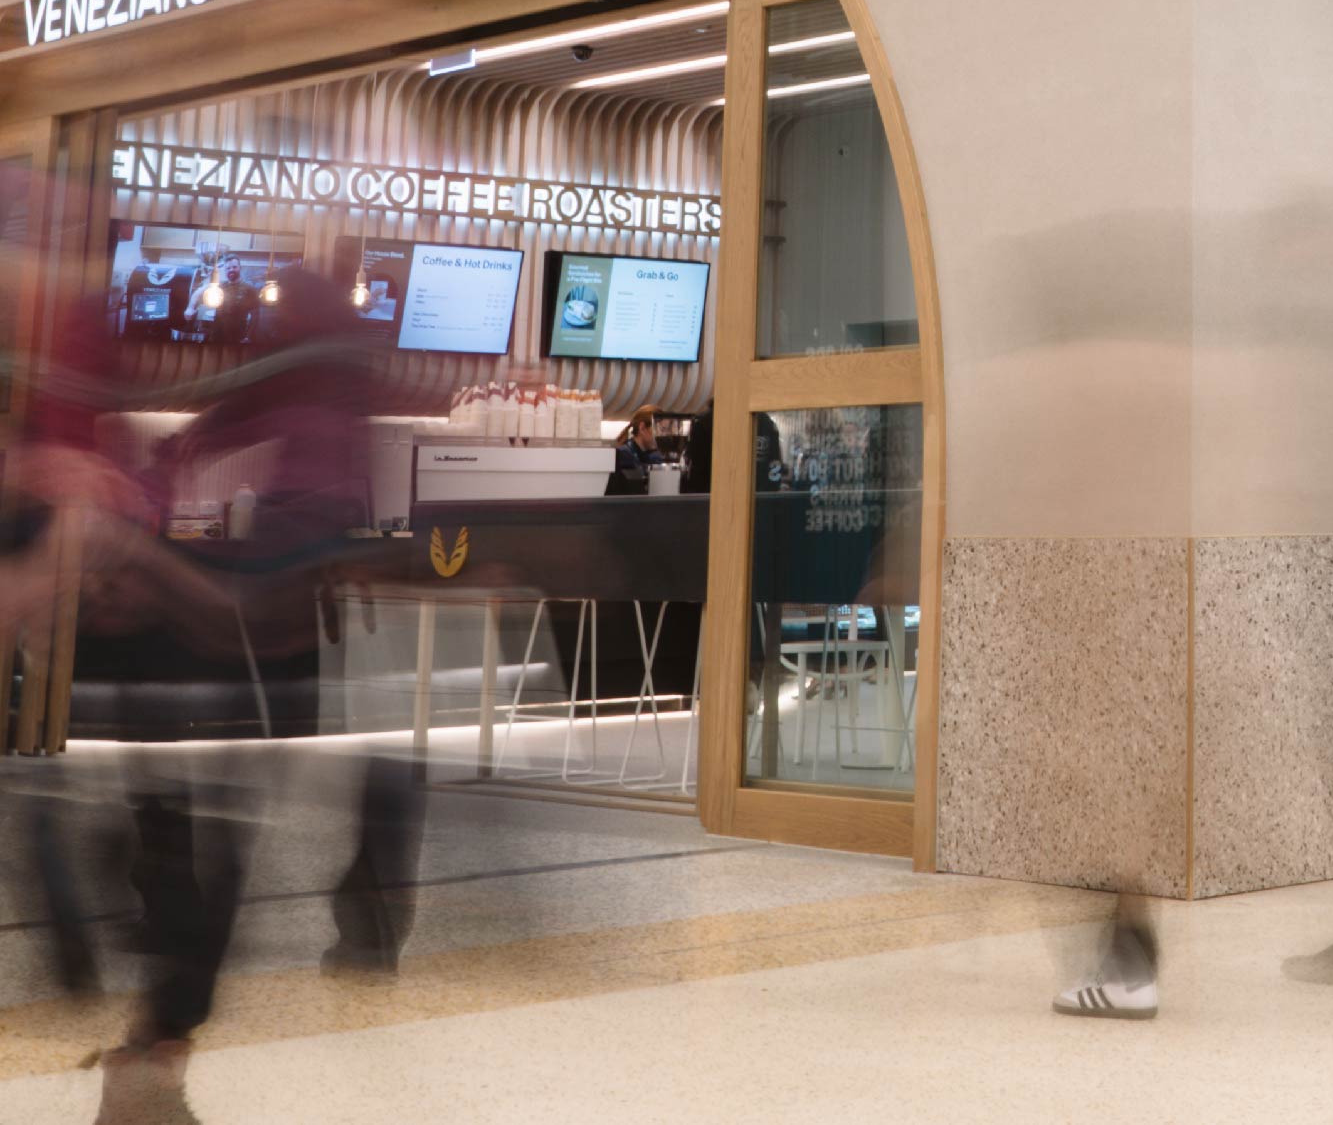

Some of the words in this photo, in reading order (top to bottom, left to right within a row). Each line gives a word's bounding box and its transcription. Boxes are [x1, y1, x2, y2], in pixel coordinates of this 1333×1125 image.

[347, 163, 514, 214] COFFEE
[528, 179, 722, 233] ROASTERS
[422, 256, 454, 267] Coffee
[455, 257, 463, 268] &
[464, 258, 481, 269] Hot
[482, 259, 513, 271] Drinks
[636, 269, 658, 280] Grab
[659, 270, 666, 280] &
[666, 271, 680, 282] Go
